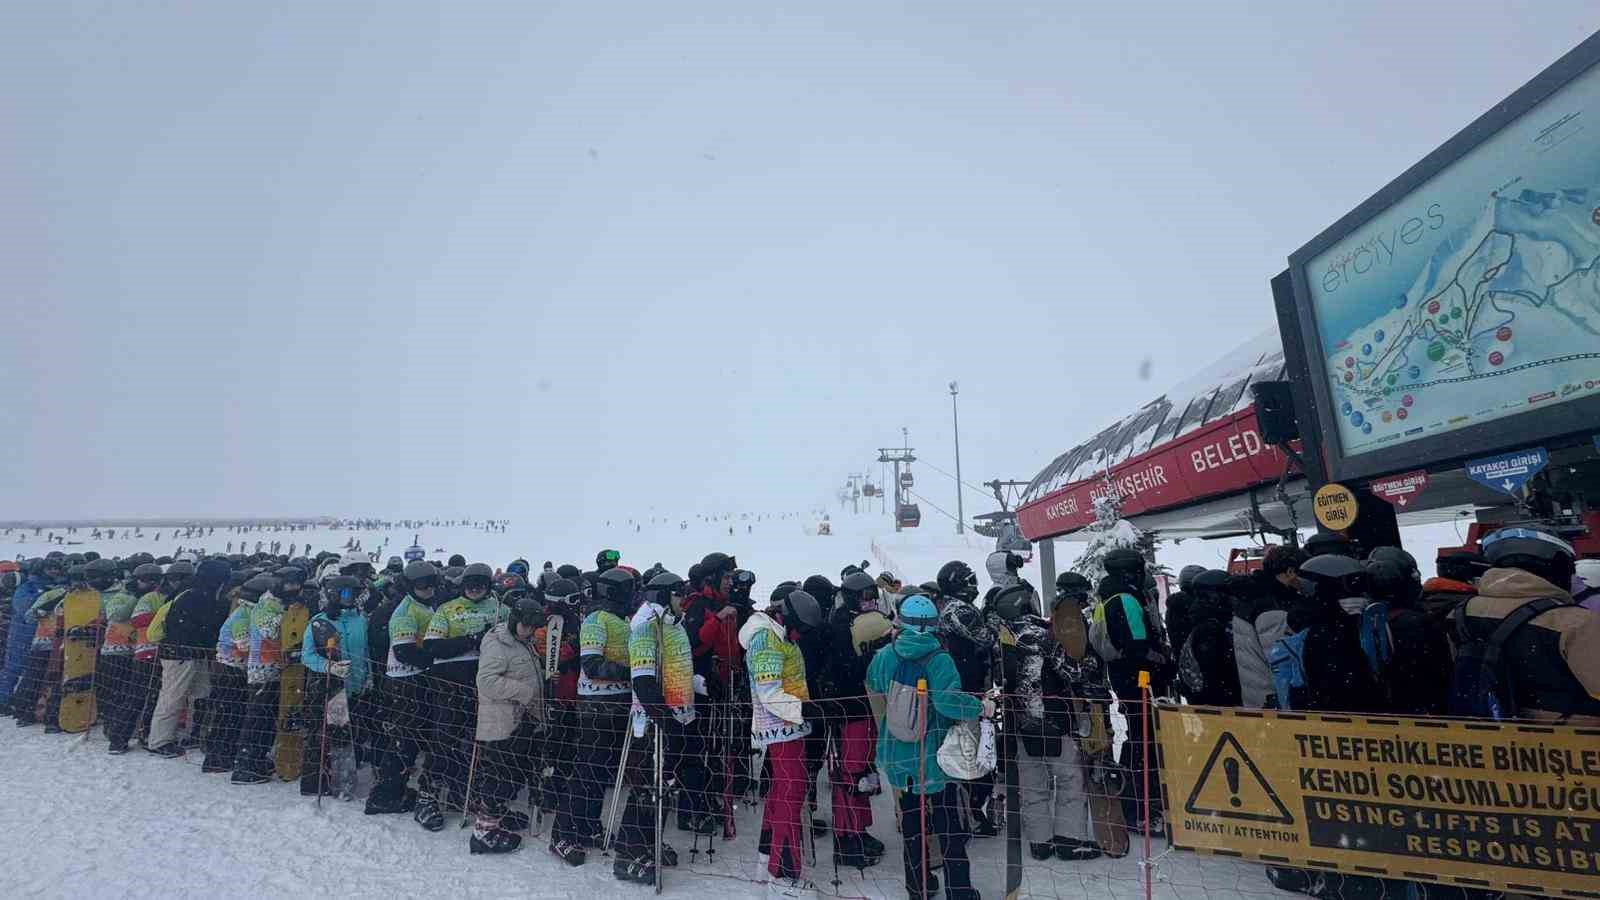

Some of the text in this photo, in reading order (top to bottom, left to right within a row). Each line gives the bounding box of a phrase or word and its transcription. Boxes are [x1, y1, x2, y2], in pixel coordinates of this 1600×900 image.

[1089, 463, 1168, 504] BÜKŞEHİR
[1191, 430, 1271, 473] BELED
[1469, 459, 1509, 475] KAYAKÇI
[549, 635, 558, 673] ATOMIC
[1295, 733, 1600, 781] TELEFERİKLERE BİNİŞLE
[1299, 766, 1600, 812] KENDİ SORUMLULUĞU
[1234, 826, 1299, 843] ATTENTION
[1315, 801, 1592, 842] USING LIFTS IS AT
